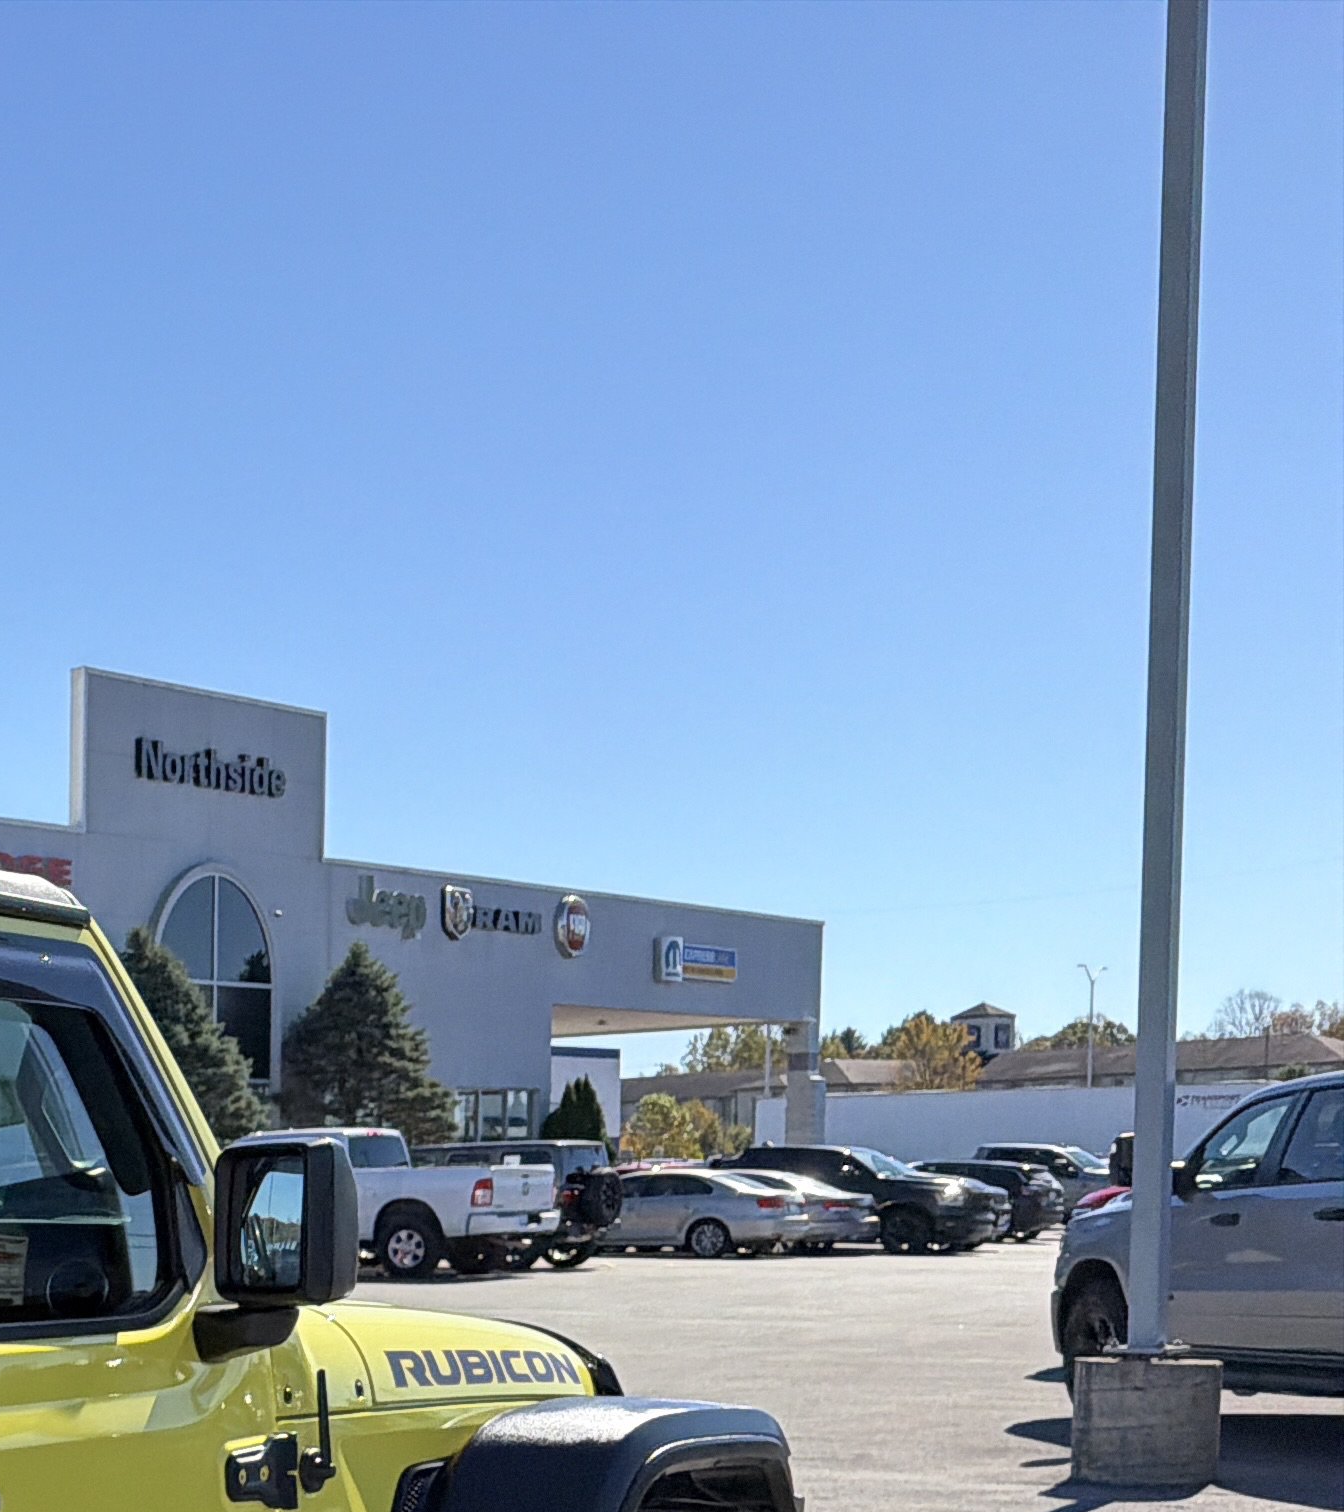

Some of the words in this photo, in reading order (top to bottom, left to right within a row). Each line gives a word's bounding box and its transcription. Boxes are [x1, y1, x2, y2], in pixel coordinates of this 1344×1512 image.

[134, 736, 287, 798] Northside
[346, 875, 427, 940] Jeep
[472, 905, 543, 935] RAM
[383, 1349, 582, 1388] RUBICON
